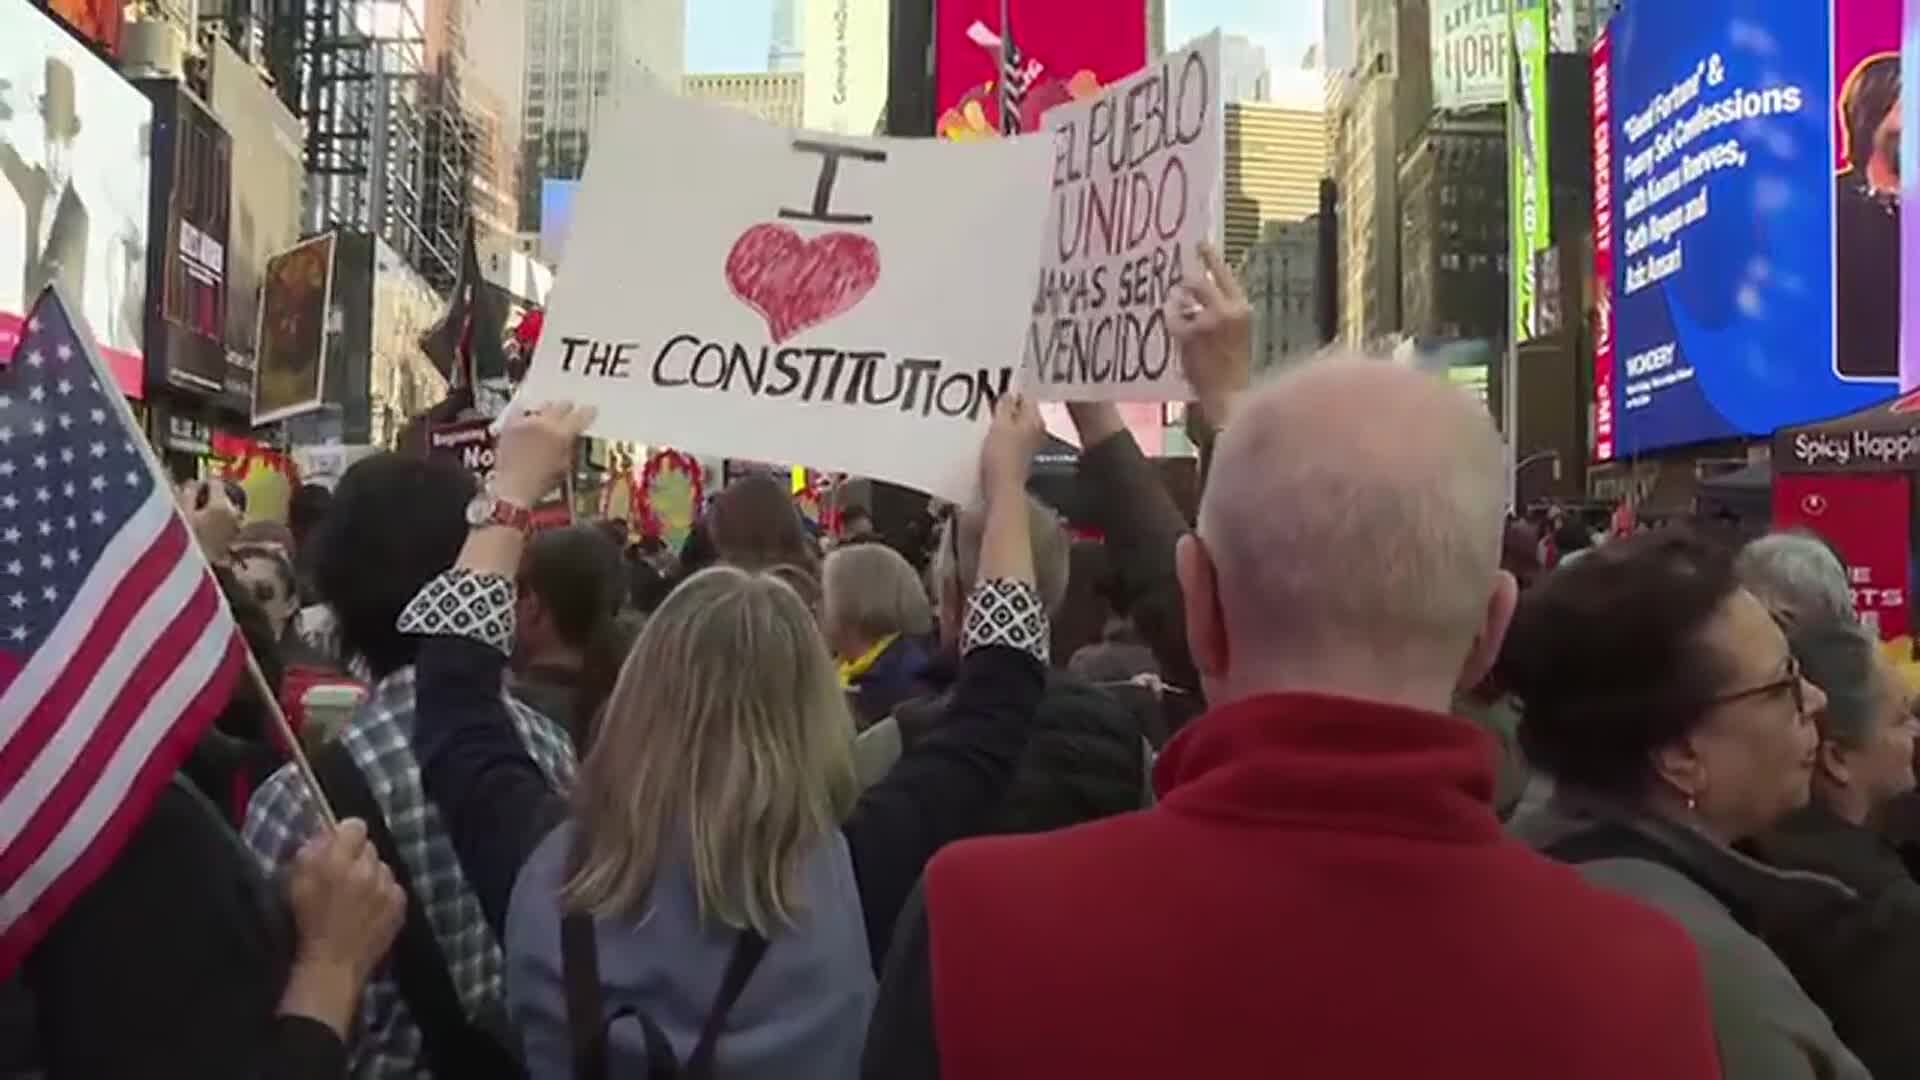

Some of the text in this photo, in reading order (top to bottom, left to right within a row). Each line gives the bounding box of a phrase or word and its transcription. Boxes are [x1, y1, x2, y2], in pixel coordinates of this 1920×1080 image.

[1706, 53, 1725, 86] &
[1053, 50, 1208, 188] EL PUEBLO
[1674, 86, 1802, 149] Confessions
[779, 140, 887, 224] I
[1058, 156, 1188, 263] UNIDO
[1118, 242, 1184, 309] SERA
[560, 333, 1012, 421] THE CONSTITUTION
[1031, 308, 1171, 385] VENCIDO
[1795, 433, 1849, 465] Spicy
